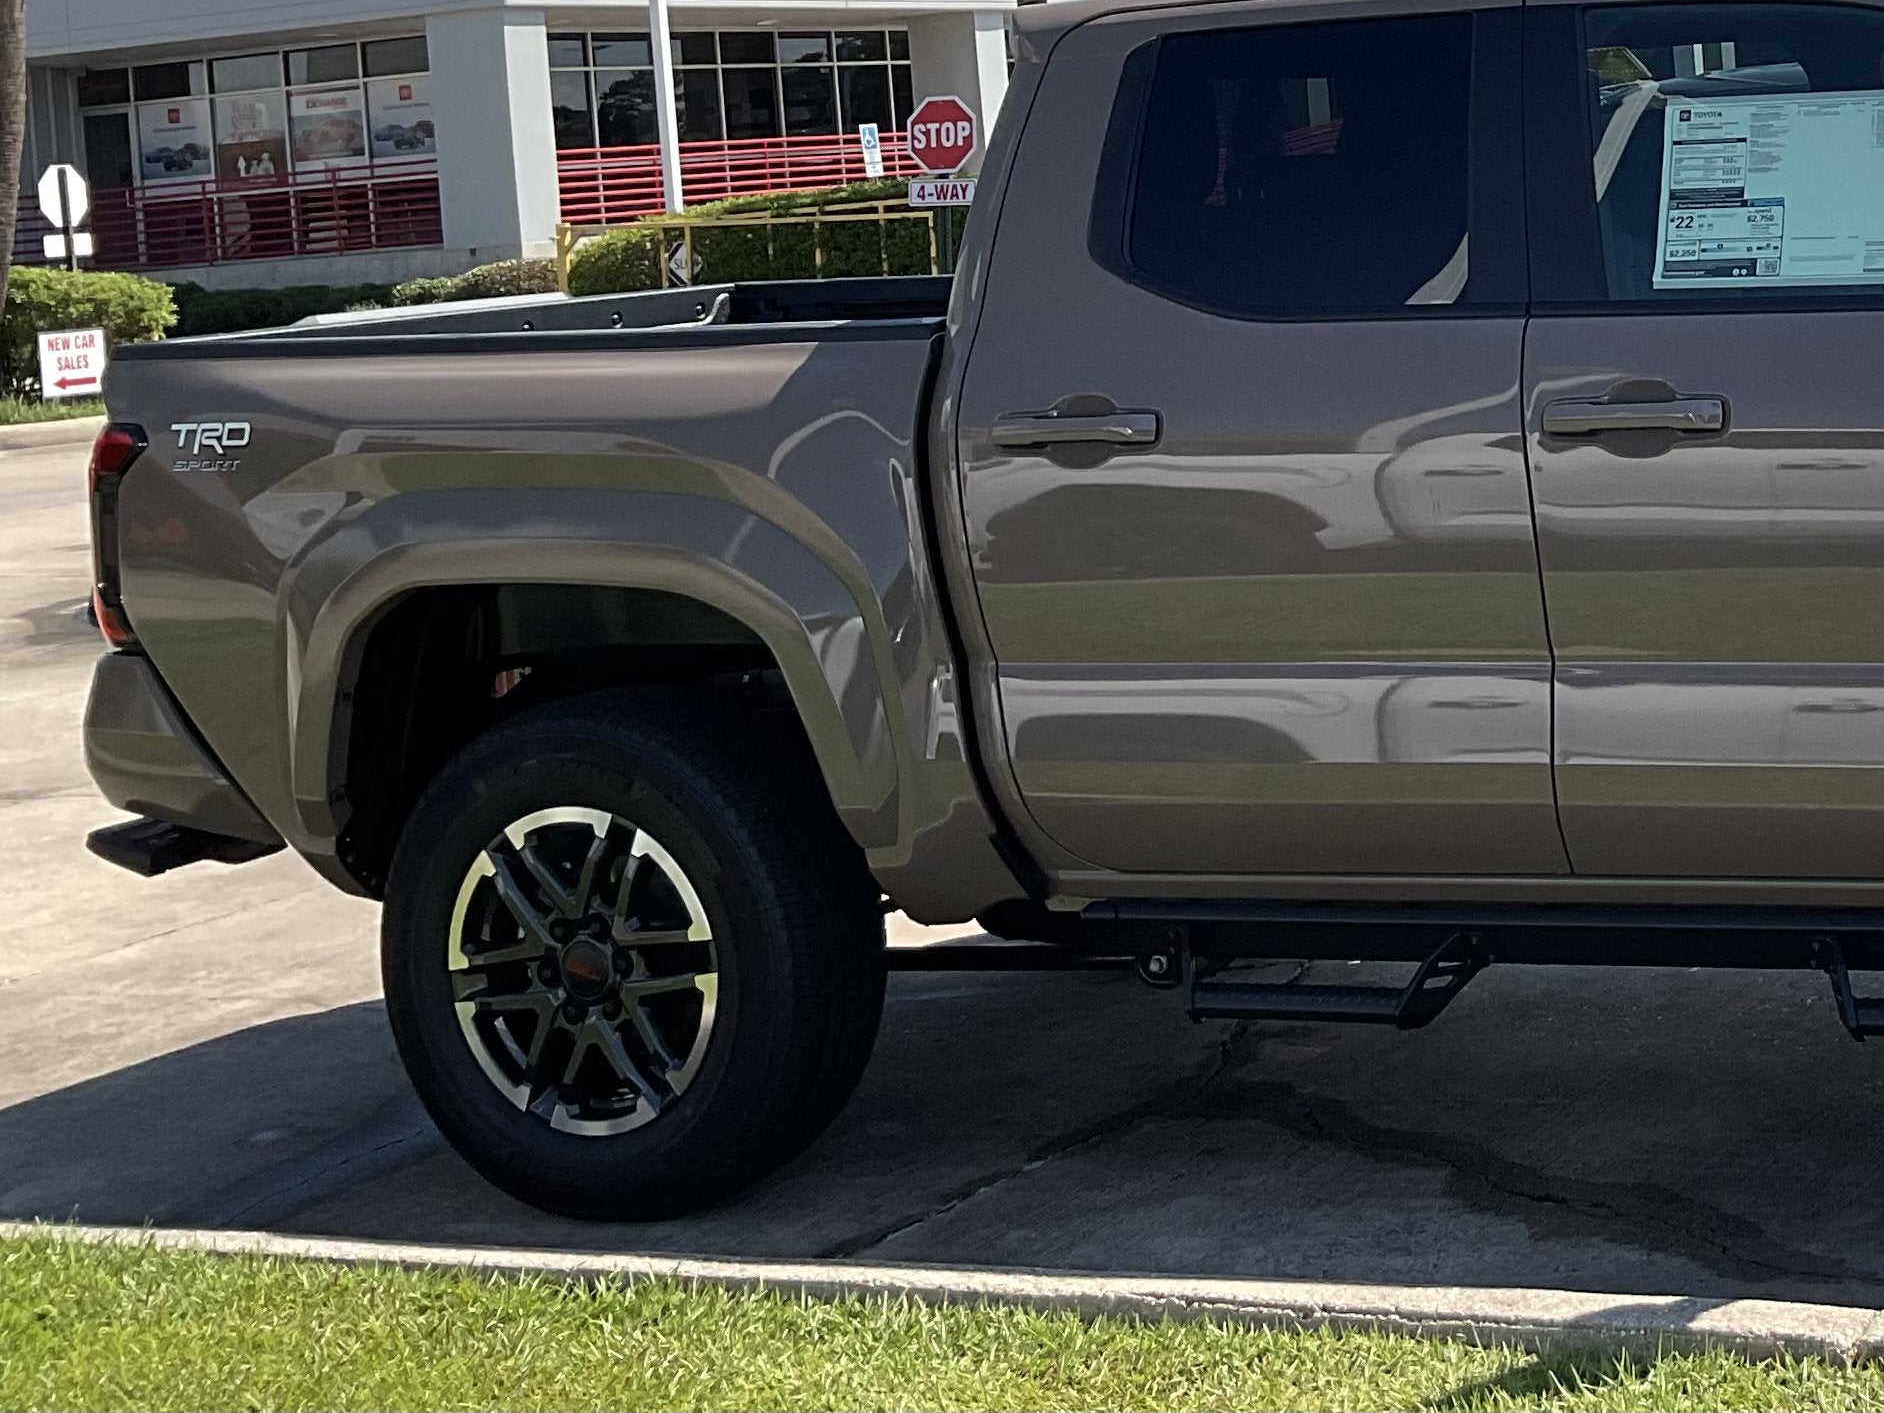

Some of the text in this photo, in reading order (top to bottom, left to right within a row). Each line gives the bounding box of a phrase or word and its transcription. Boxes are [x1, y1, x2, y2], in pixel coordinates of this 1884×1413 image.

[913, 121, 971, 149] STOP
[917, 184, 969, 201] 4-WAY
[1675, 215, 1695, 229] 22
[47, 334, 95, 351] NEW CAR
[57, 354, 89, 371] SALES
[170, 421, 251, 455] TRD
[172, 459, 241, 472] SPORT
